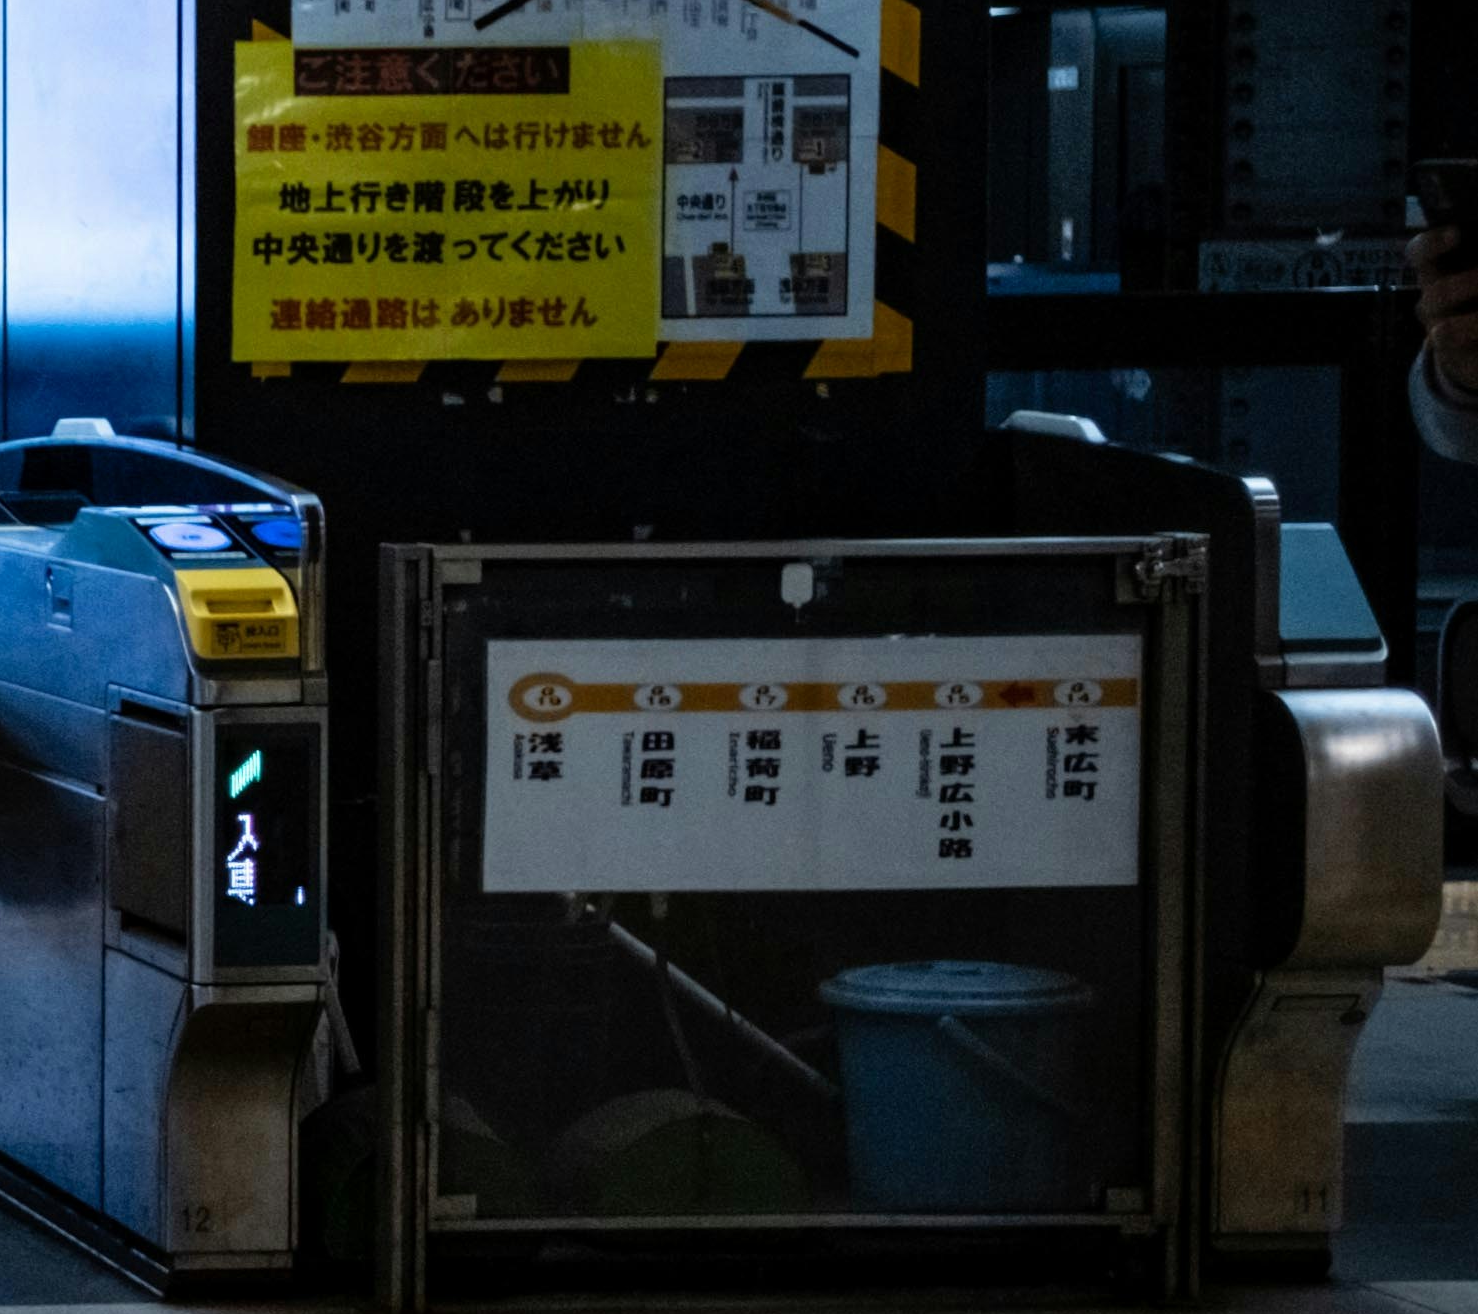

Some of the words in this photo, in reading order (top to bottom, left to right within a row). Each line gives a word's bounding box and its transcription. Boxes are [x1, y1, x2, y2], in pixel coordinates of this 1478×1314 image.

[298, 53, 559, 87] ご注意ください
[247, 122, 652, 152] 銀座・渋谷方面へは行けません
[279, 180, 609, 213] 地上行き階段を上がり
[676, 193, 726, 210] 中央通り
[253, 231, 626, 266] 中央通りを渡ってください
[270, 299, 598, 332] 連絡通路はありません
[528, 732, 562, 780] 浅草
[640, 731, 675, 807] 田原町
[745, 729, 781, 805] 稲荷町
[822, 732, 836, 773] Ueno
[845, 729, 880, 778] 上野
[1064, 725, 1099, 801] 末広町
[939, 727, 975, 859] 上野広小路
[181, 1206, 211, 1233] 12
